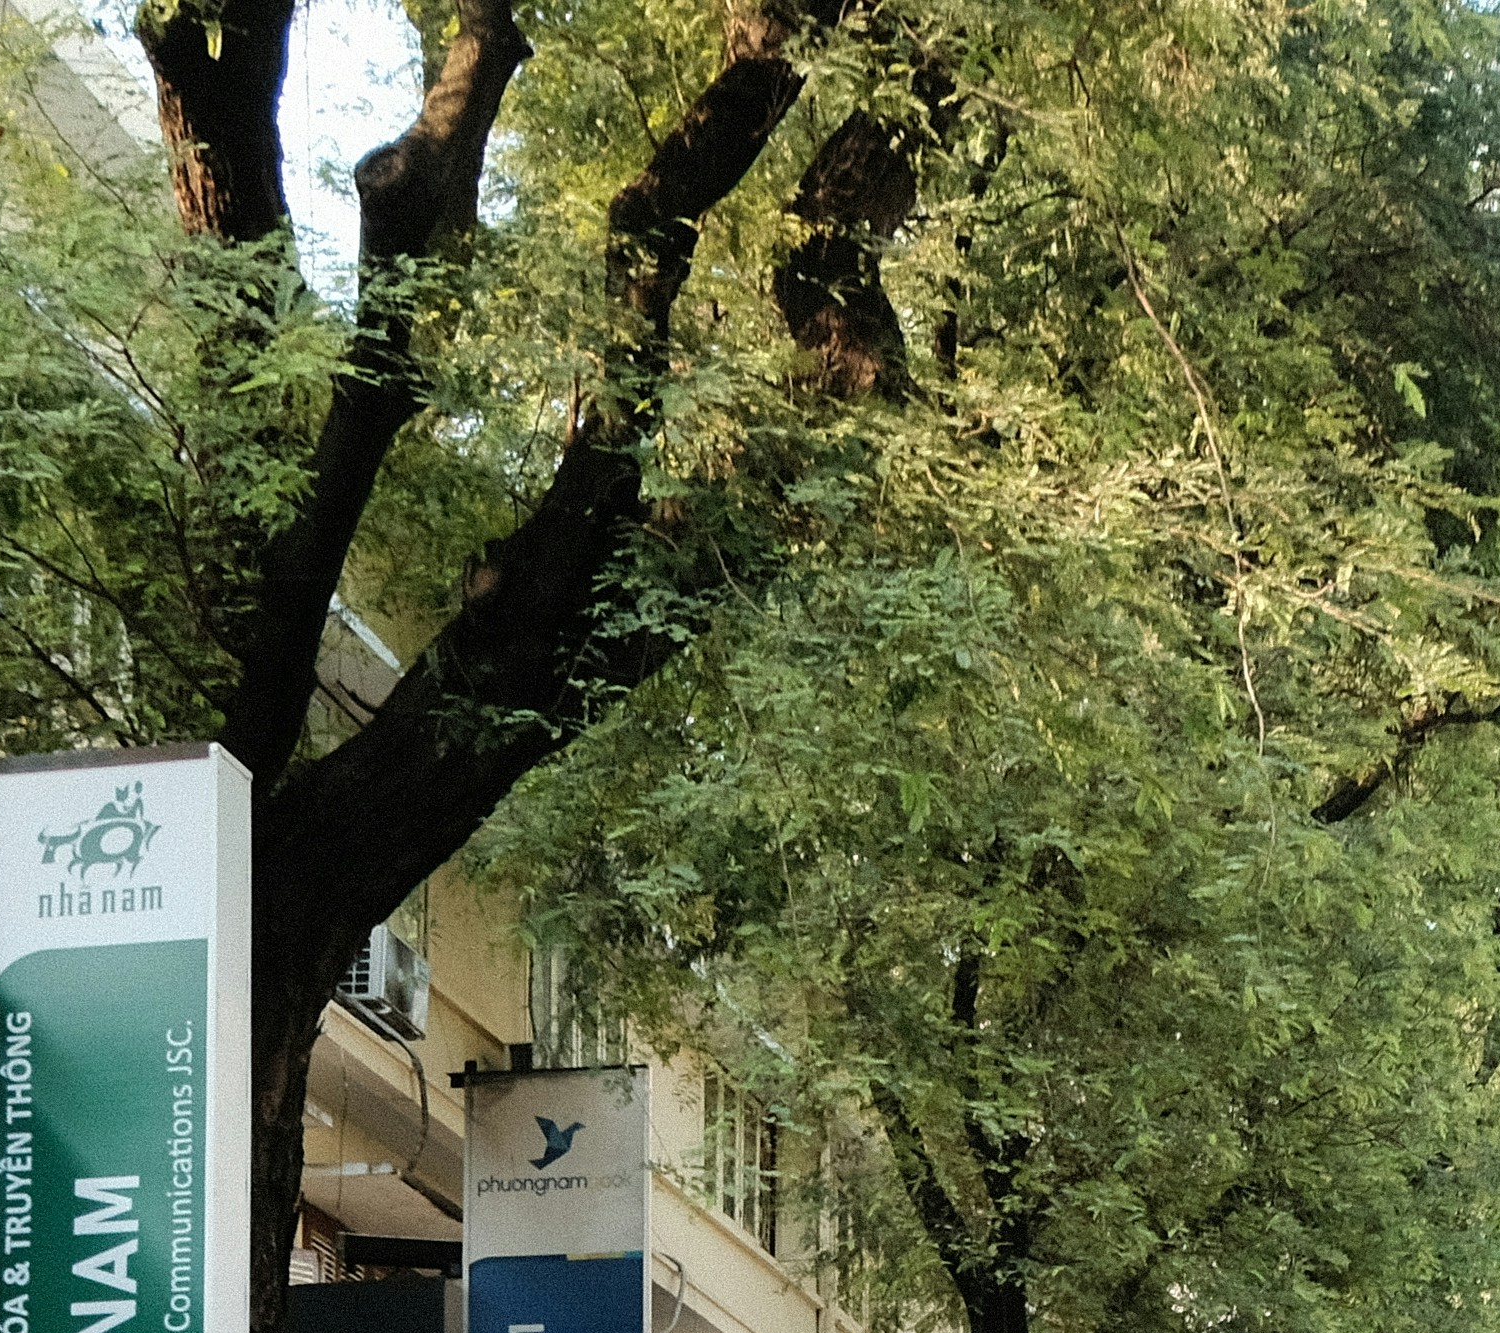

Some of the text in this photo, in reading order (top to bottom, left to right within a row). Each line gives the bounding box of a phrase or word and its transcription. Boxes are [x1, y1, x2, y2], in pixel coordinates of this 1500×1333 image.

[101, 884, 164, 914] nam
[162, 1081, 192, 1332] Communications
[5, 1261, 31, 1286] &
